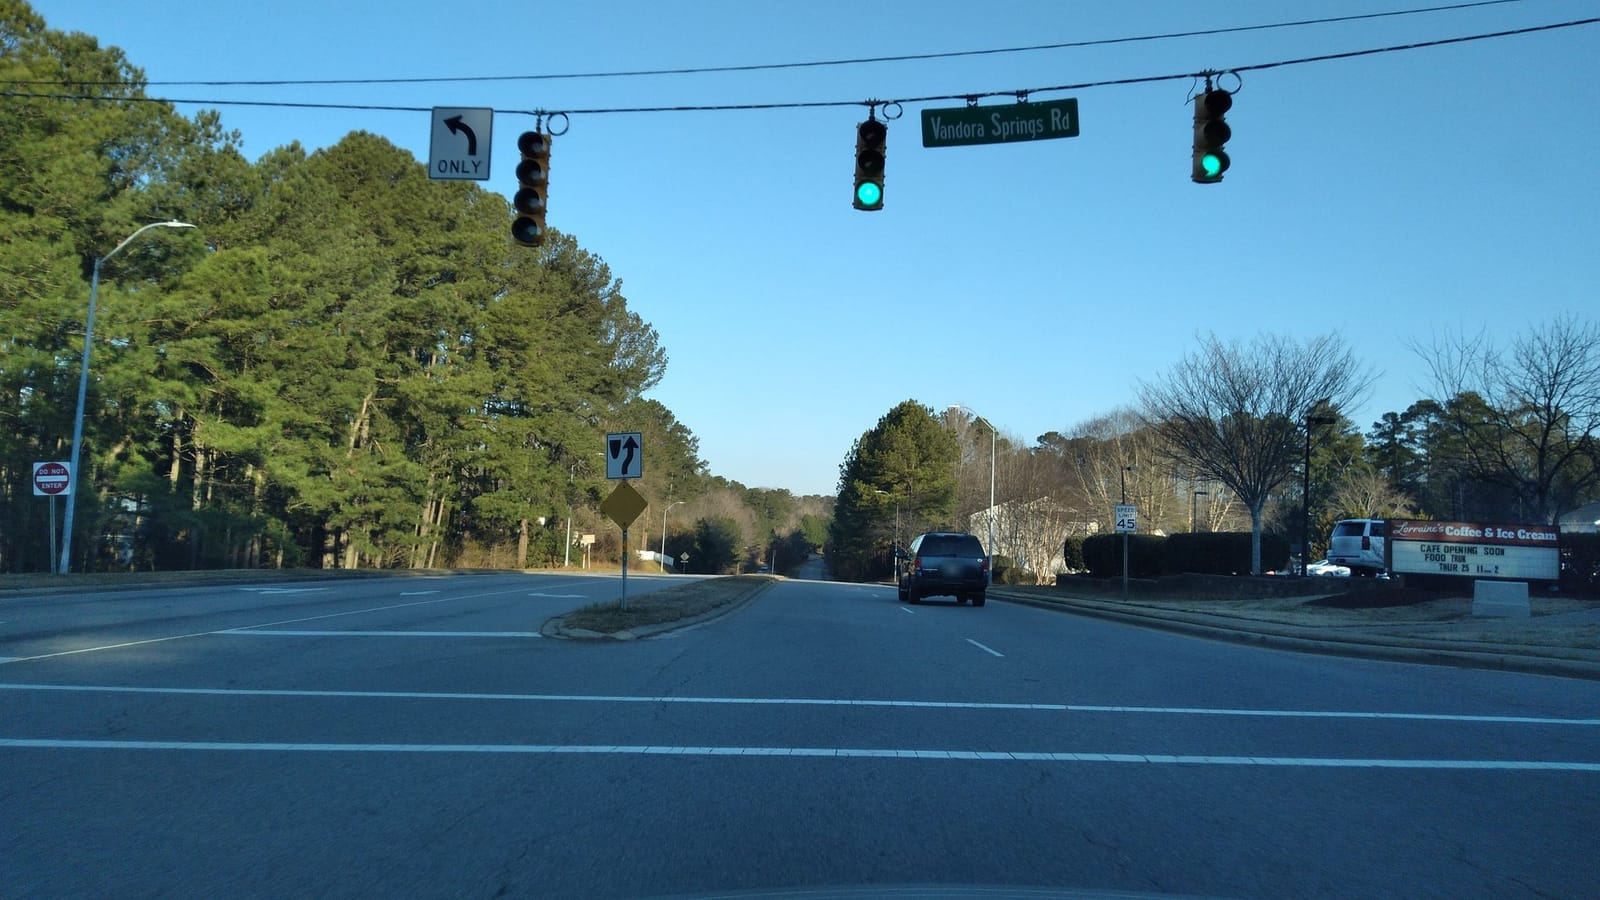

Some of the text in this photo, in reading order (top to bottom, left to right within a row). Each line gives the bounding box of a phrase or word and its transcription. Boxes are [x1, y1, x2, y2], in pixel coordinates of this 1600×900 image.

[931, 108, 1070, 141] Vandora Springs Rd
[438, 159, 481, 174] ONLY
[1116, 518, 1135, 529] 45
[1392, 521, 1557, 541] Lorraine's Coffee & Ice Cream
[1420, 544, 1505, 556] CAFE OPENING SOON
[1424, 553, 1446, 562] FOOD
[1439, 562, 1458, 572] THUR
